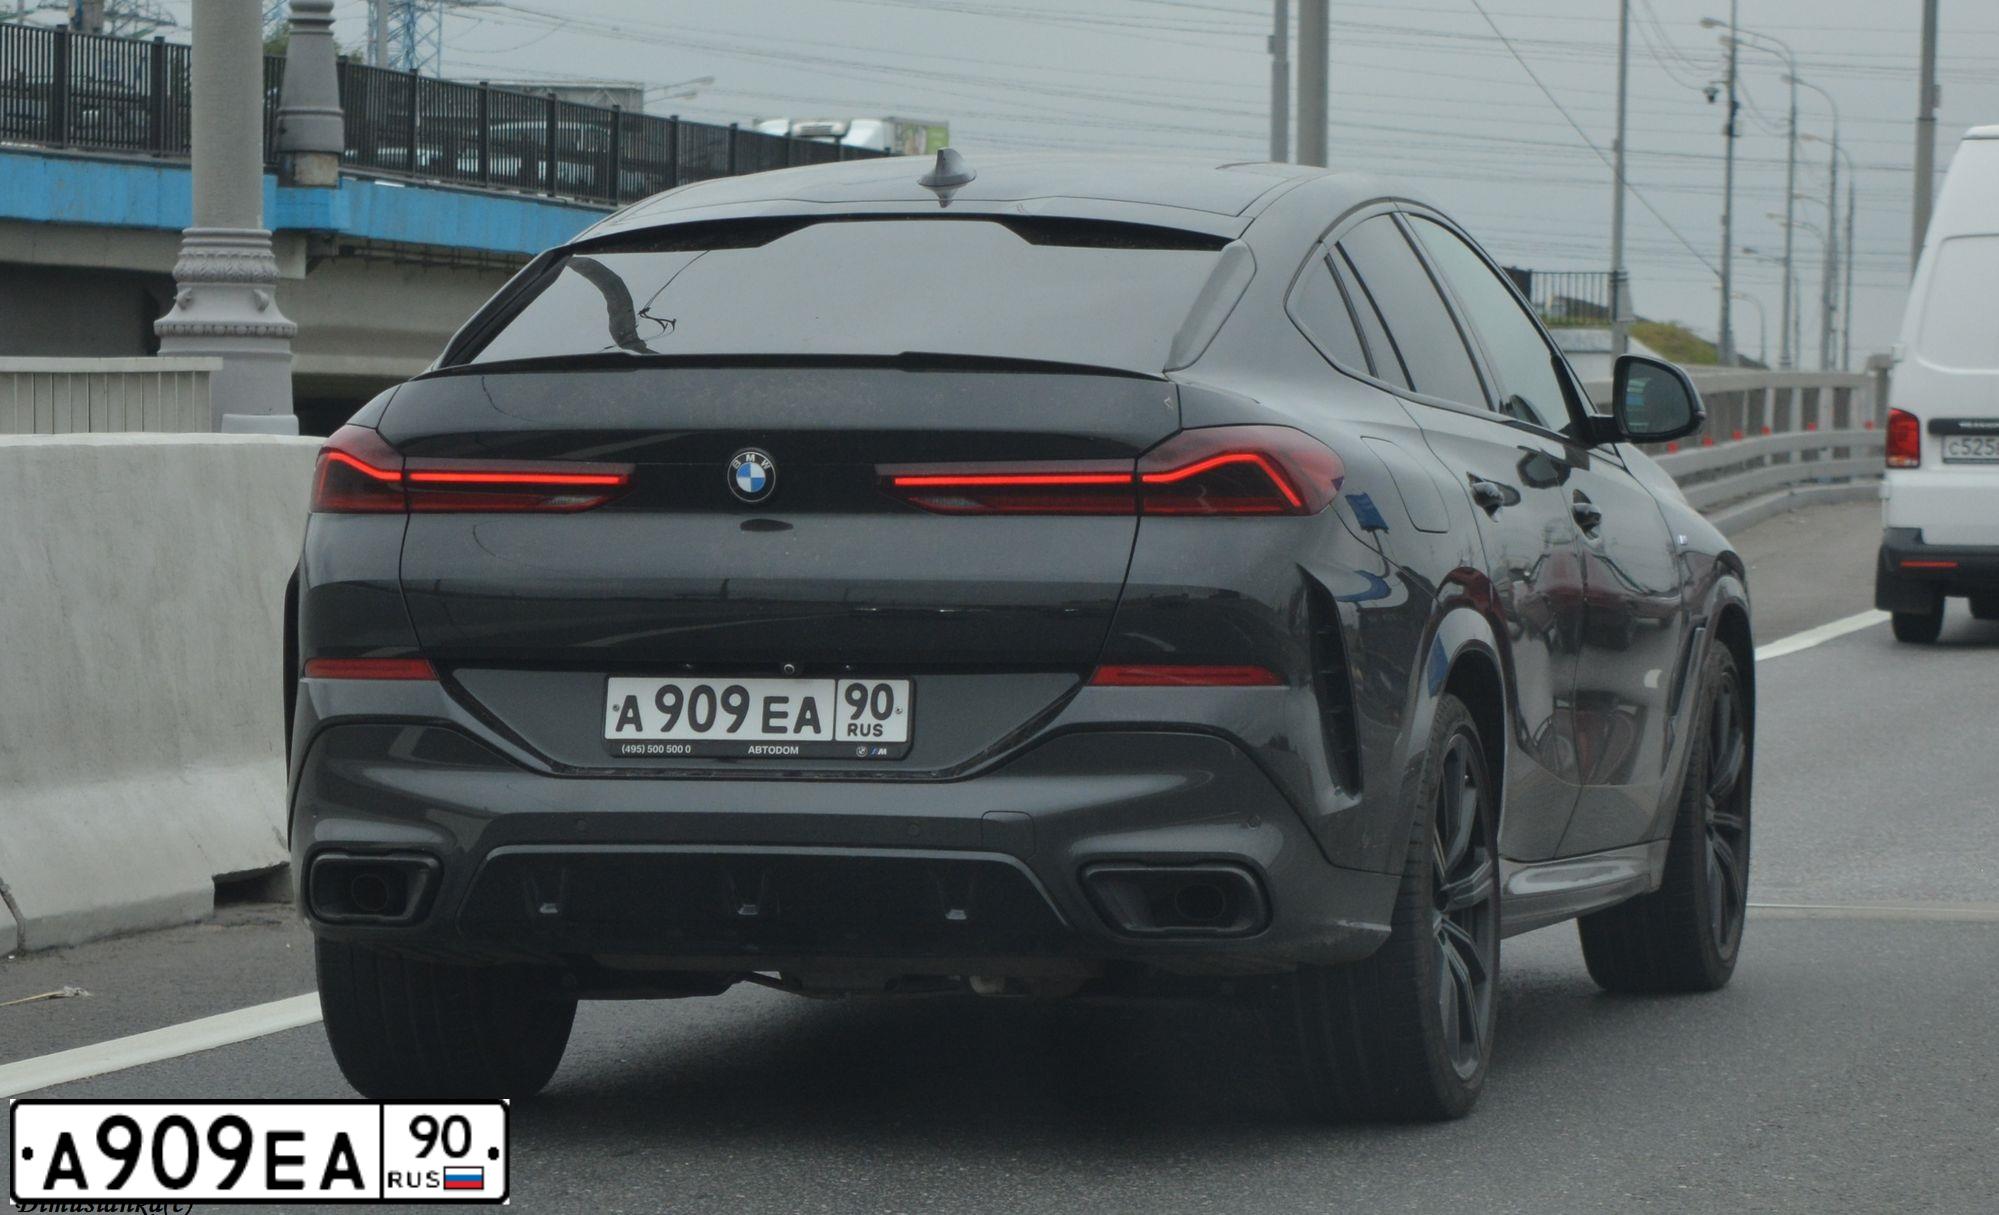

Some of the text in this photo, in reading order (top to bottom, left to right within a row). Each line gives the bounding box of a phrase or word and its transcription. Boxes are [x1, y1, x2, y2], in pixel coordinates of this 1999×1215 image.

[1948, 437, 1999, 456] C525
[732, 453, 771, 470] BMW
[844, 682, 895, 721] 90
[847, 723, 883, 737] RUS
[621, 744, 645, 754] (495)
